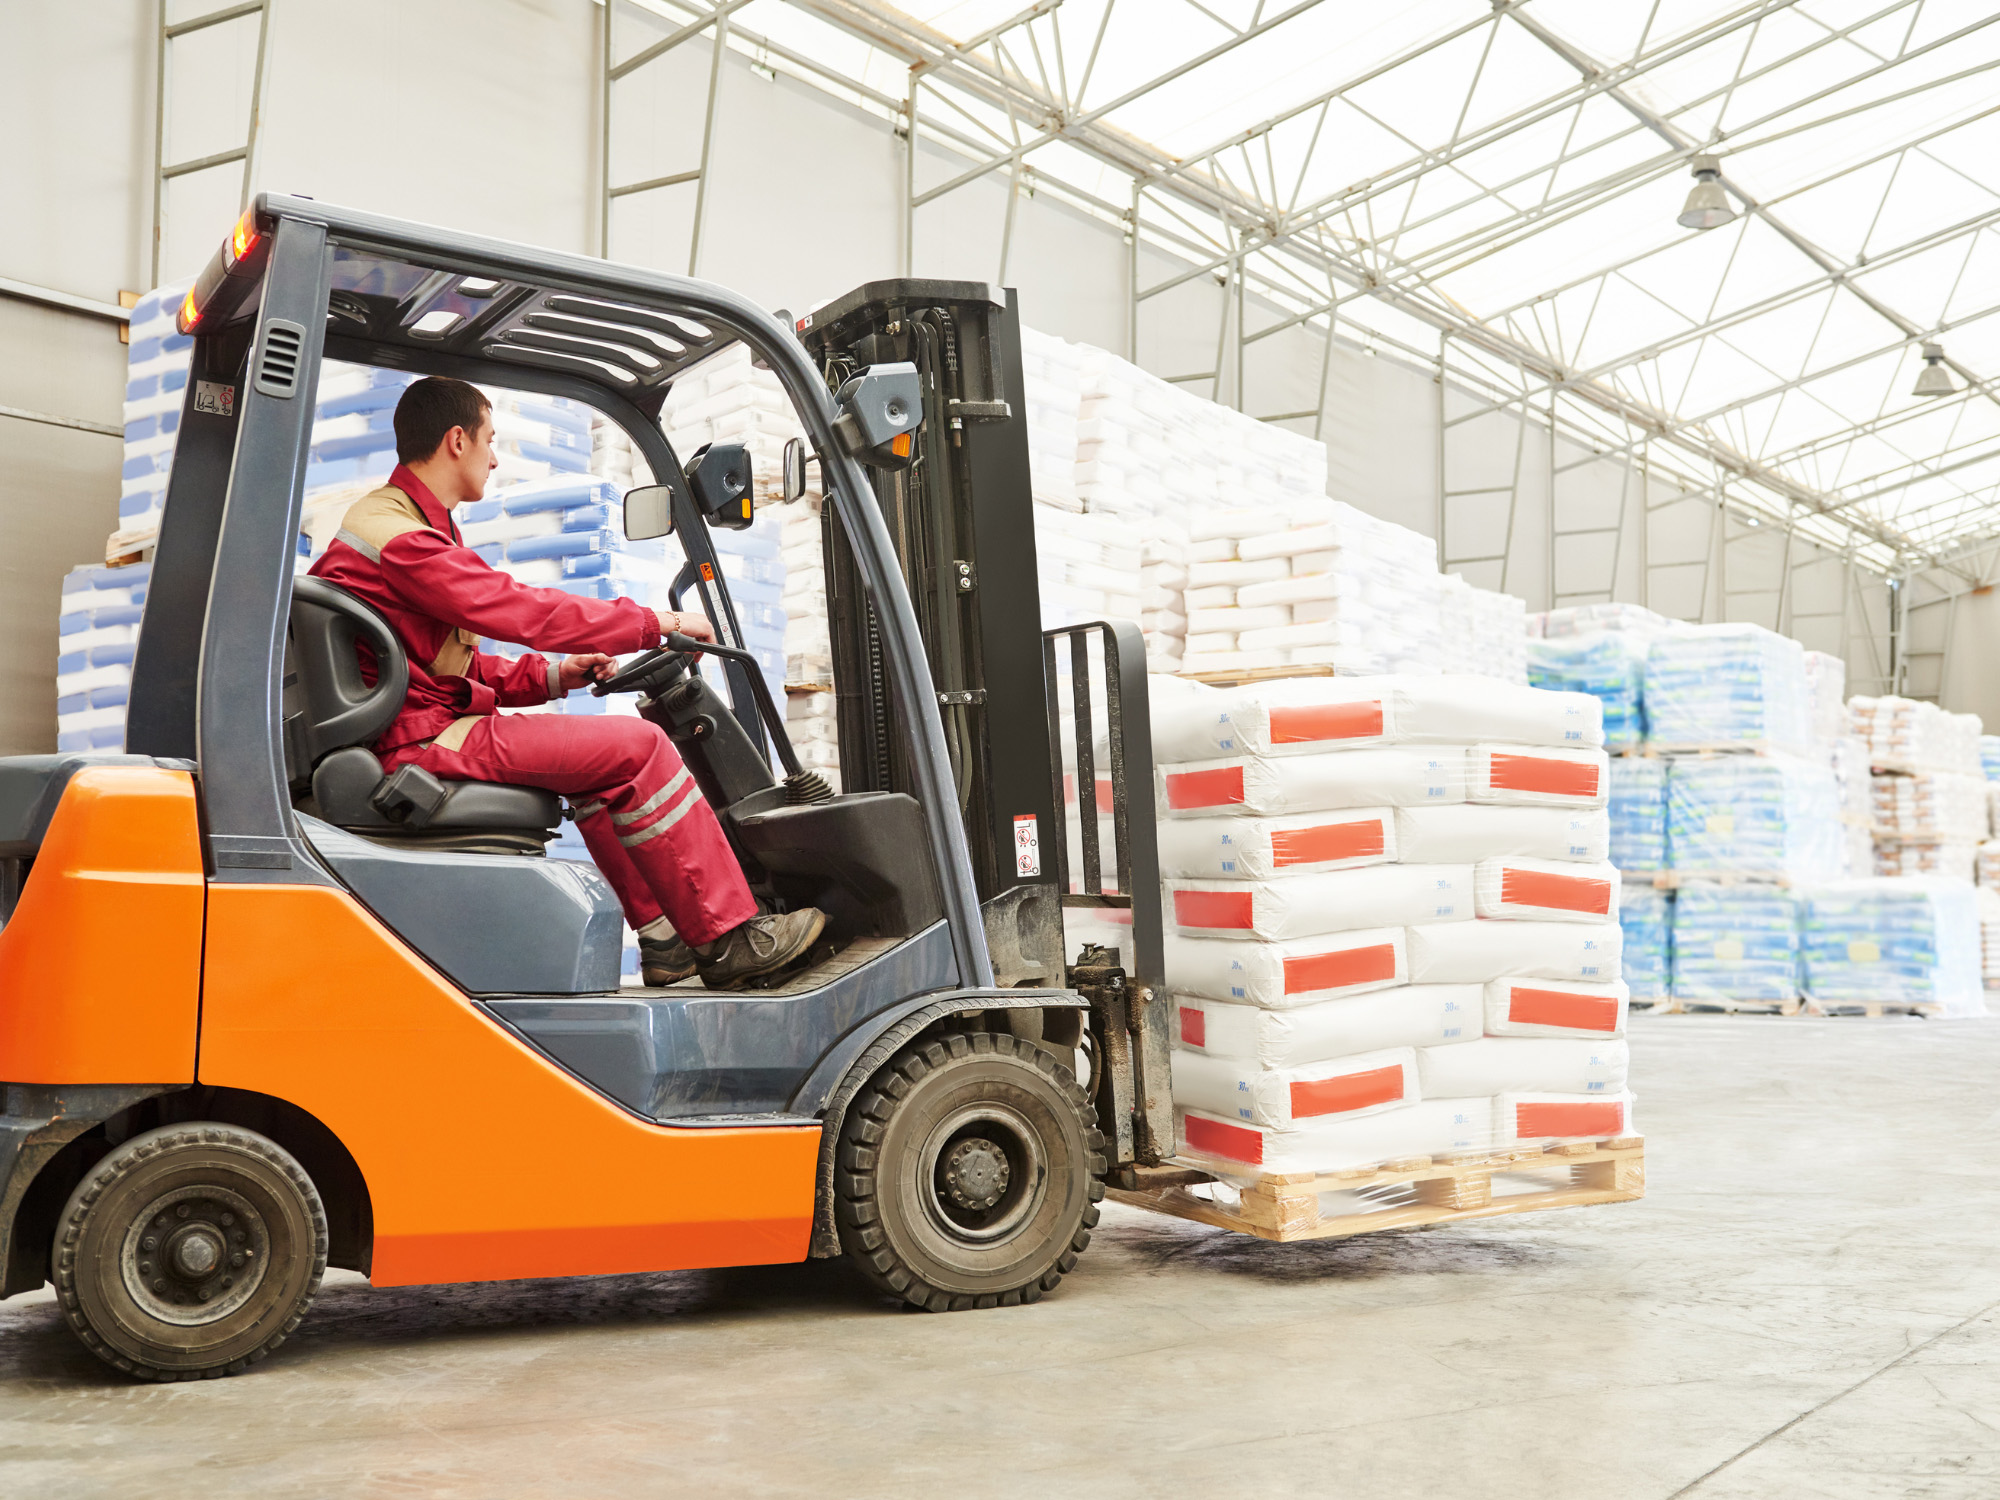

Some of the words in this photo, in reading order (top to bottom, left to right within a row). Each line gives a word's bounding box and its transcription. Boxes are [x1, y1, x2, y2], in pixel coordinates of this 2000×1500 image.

[1428, 761, 1437, 771] 30
[1570, 821, 1579, 830] 30
[1436, 880, 1445, 889] 30
[1584, 940, 1593, 950] 30
[1445, 1001, 1454, 1012] 30
[1589, 1056, 1598, 1066] 30
[1454, 1114, 1463, 1124] 30
